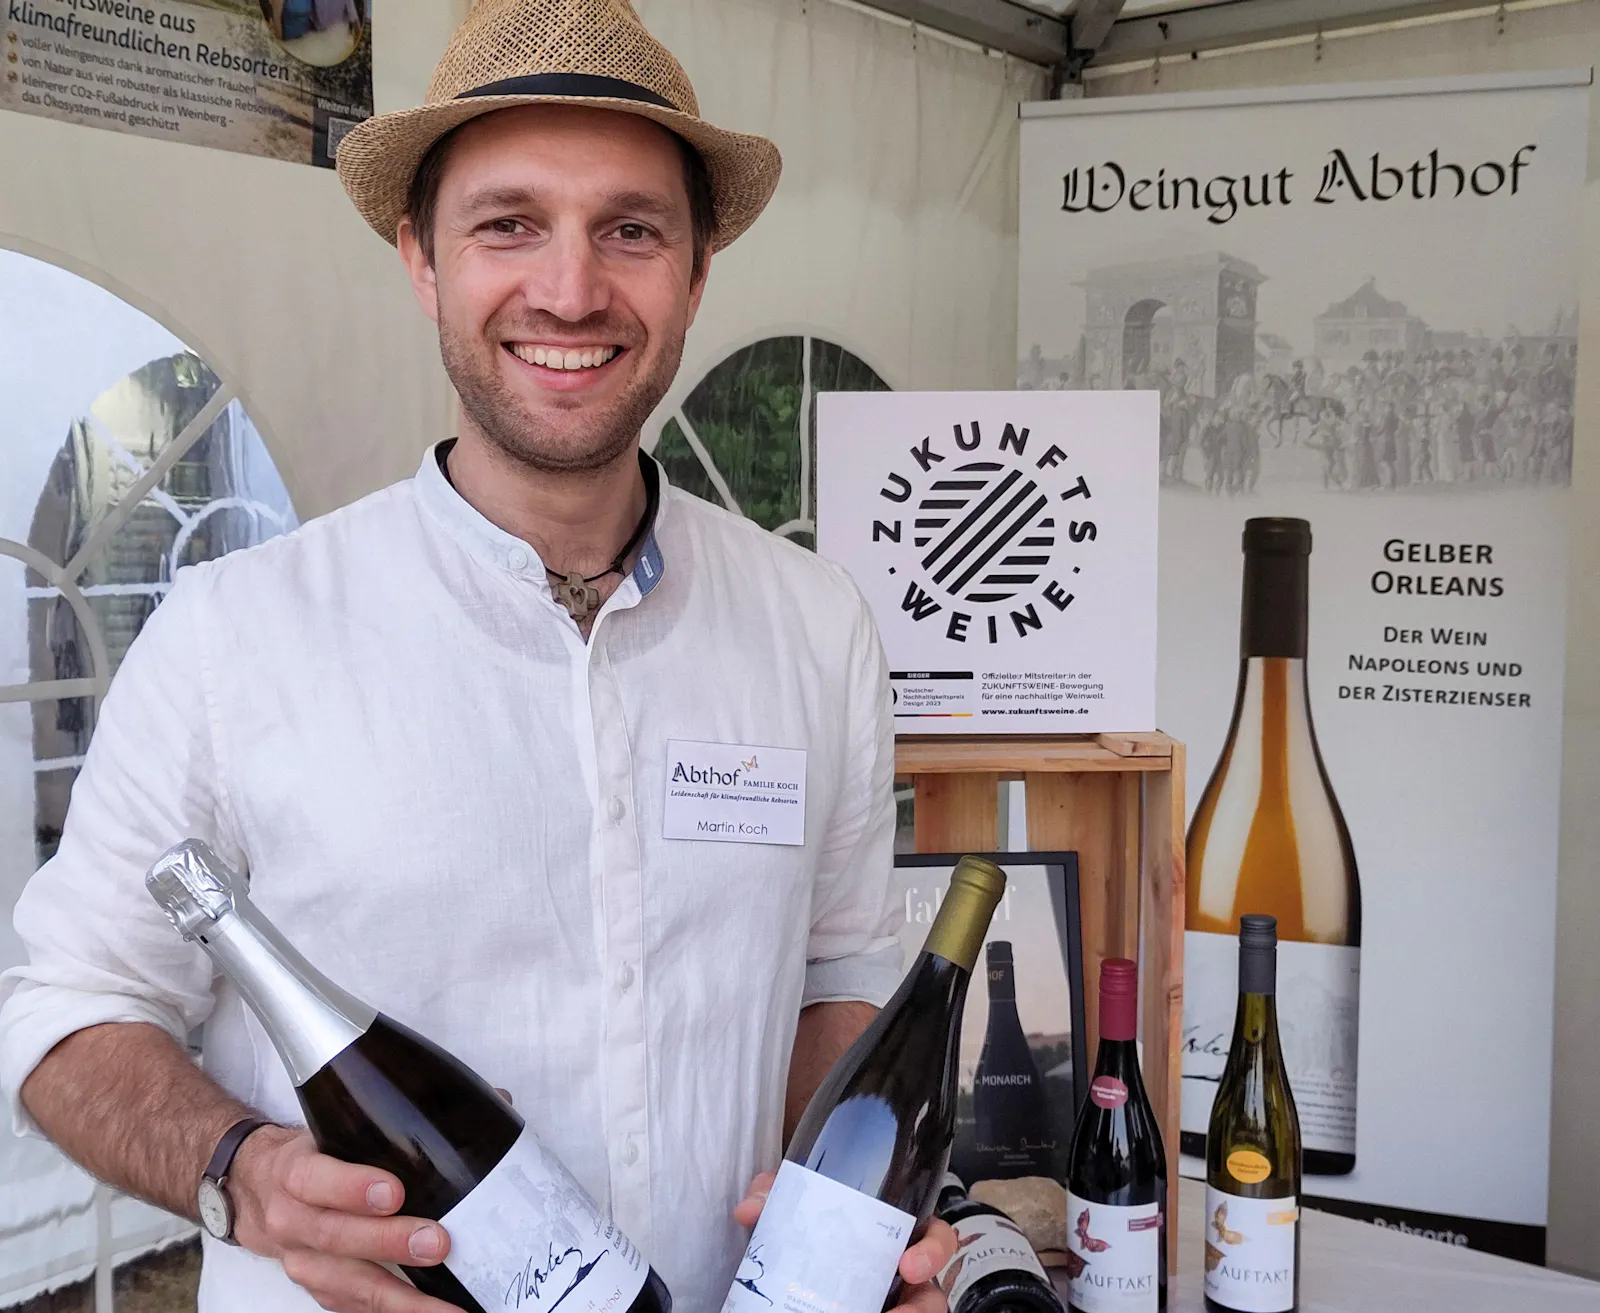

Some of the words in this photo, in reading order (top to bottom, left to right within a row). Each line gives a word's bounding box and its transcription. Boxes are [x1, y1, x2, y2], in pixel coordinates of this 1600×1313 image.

[160, 12, 196, 34] aus
[9, 0, 191, 62] klimafreundlichen
[196, 43, 290, 81] Rebsorten
[22, 37, 52, 52] voller
[54, 42, 116, 65] Weingenuss
[117, 59, 143, 74] dank
[145, 65, 214, 87] aromatischer
[218, 77, 257, 95] Trauben
[22, 57, 42, 69] von
[44, 60, 73, 76] Natur
[76, 69, 94, 81] aus
[95, 72, 113, 84] viel
[116, 77, 160, 95] robuster
[163, 86, 179, 98] als
[180, 90, 233, 109] klassische
[22, 74, 68, 94] kleinerer
[162, 102, 175, 115] im
[177, 106, 227, 128] Weinberg
[317, 97, 350, 115] Weitere
[22, 91, 41, 105] das
[43, 91, 100, 117] Ökosystem
[102, 109, 126, 122] wird
[128, 113, 180, 133] geschützt
[1060, 161, 1295, 226] Weingut
[1313, 145, 1537, 205] Abthof
[872, 421, 1097, 543] ZUKUNFTS
[900, 580, 1075, 644] WEINE
[981, 682, 1104, 691] ZUKUNFTSWEINE-Bewegung
[1078, 672, 1093, 680] der
[981, 692, 993, 700] für
[1014, 692, 1063, 701] nachhaltige
[1064, 692, 1105, 700] Weinwelt.
[981, 707, 1089, 715] www.zukunftsweine.de
[671, 761, 741, 787] Abthof
[743, 779, 775, 789] FAMILIE
[777, 781, 799, 791] KOCH
[670, 789, 709, 800] Leidenschaft
[710, 791, 720, 801] für
[720, 792, 770, 803] klimafreundliche
[771, 795, 798, 805] Rebsorten
[697, 820, 735, 834] Martin
[738, 822, 768, 836] Koch
[981, 1074, 1032, 1087] MONARCH
[1084, 1271, 1154, 1291] AUFTAKT
[1215, 1264, 1290, 1284] AUFTAKT
